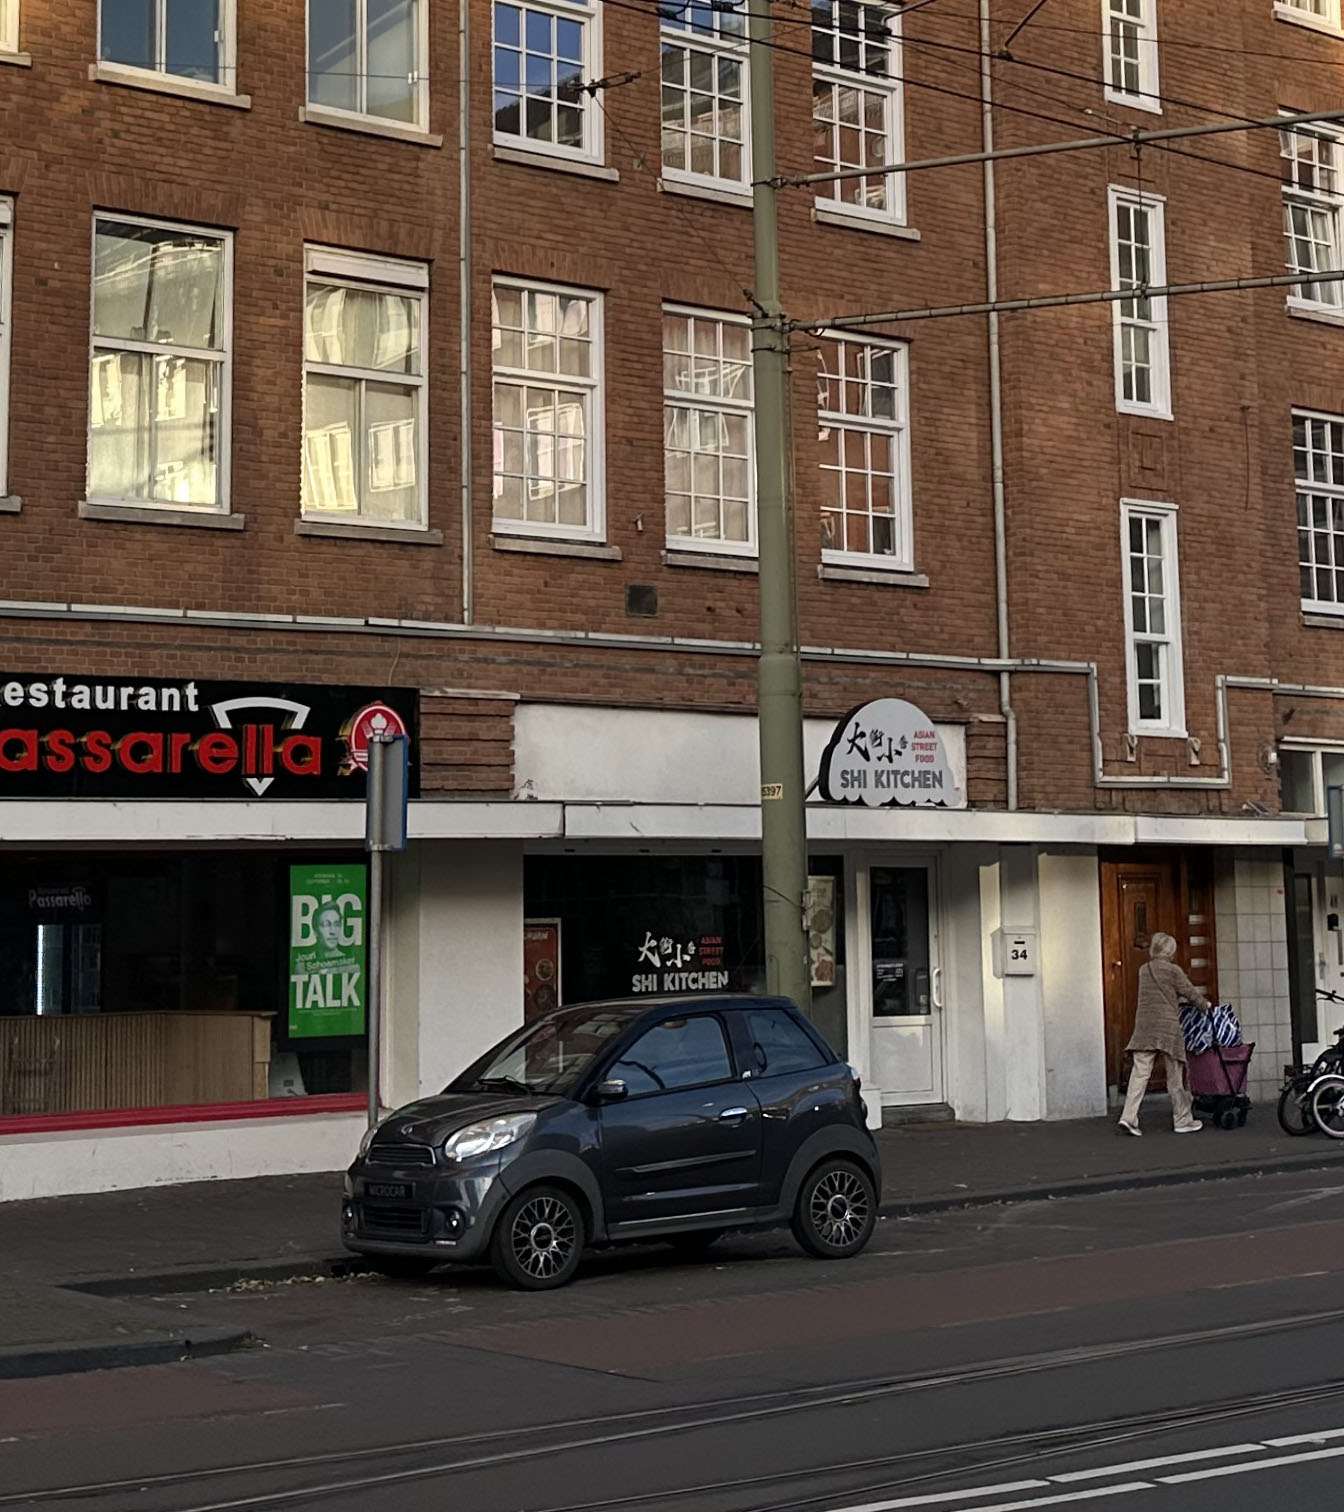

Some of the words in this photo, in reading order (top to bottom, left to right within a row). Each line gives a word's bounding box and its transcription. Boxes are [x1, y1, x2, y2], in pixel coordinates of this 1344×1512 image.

[913, 730, 936, 739] ASIAN
[911, 742, 938, 751] STREET
[915, 754, 935, 763] FOOD
[840, 769, 868, 789] SHI
[874, 769, 944, 789] KITCHEN
[291, 893, 362, 947] BG
[1011, 949, 1028, 960] 34
[632, 973, 658, 992] SHI
[664, 970, 729, 991] KITCHEN
[290, 972, 361, 1008] TALK
